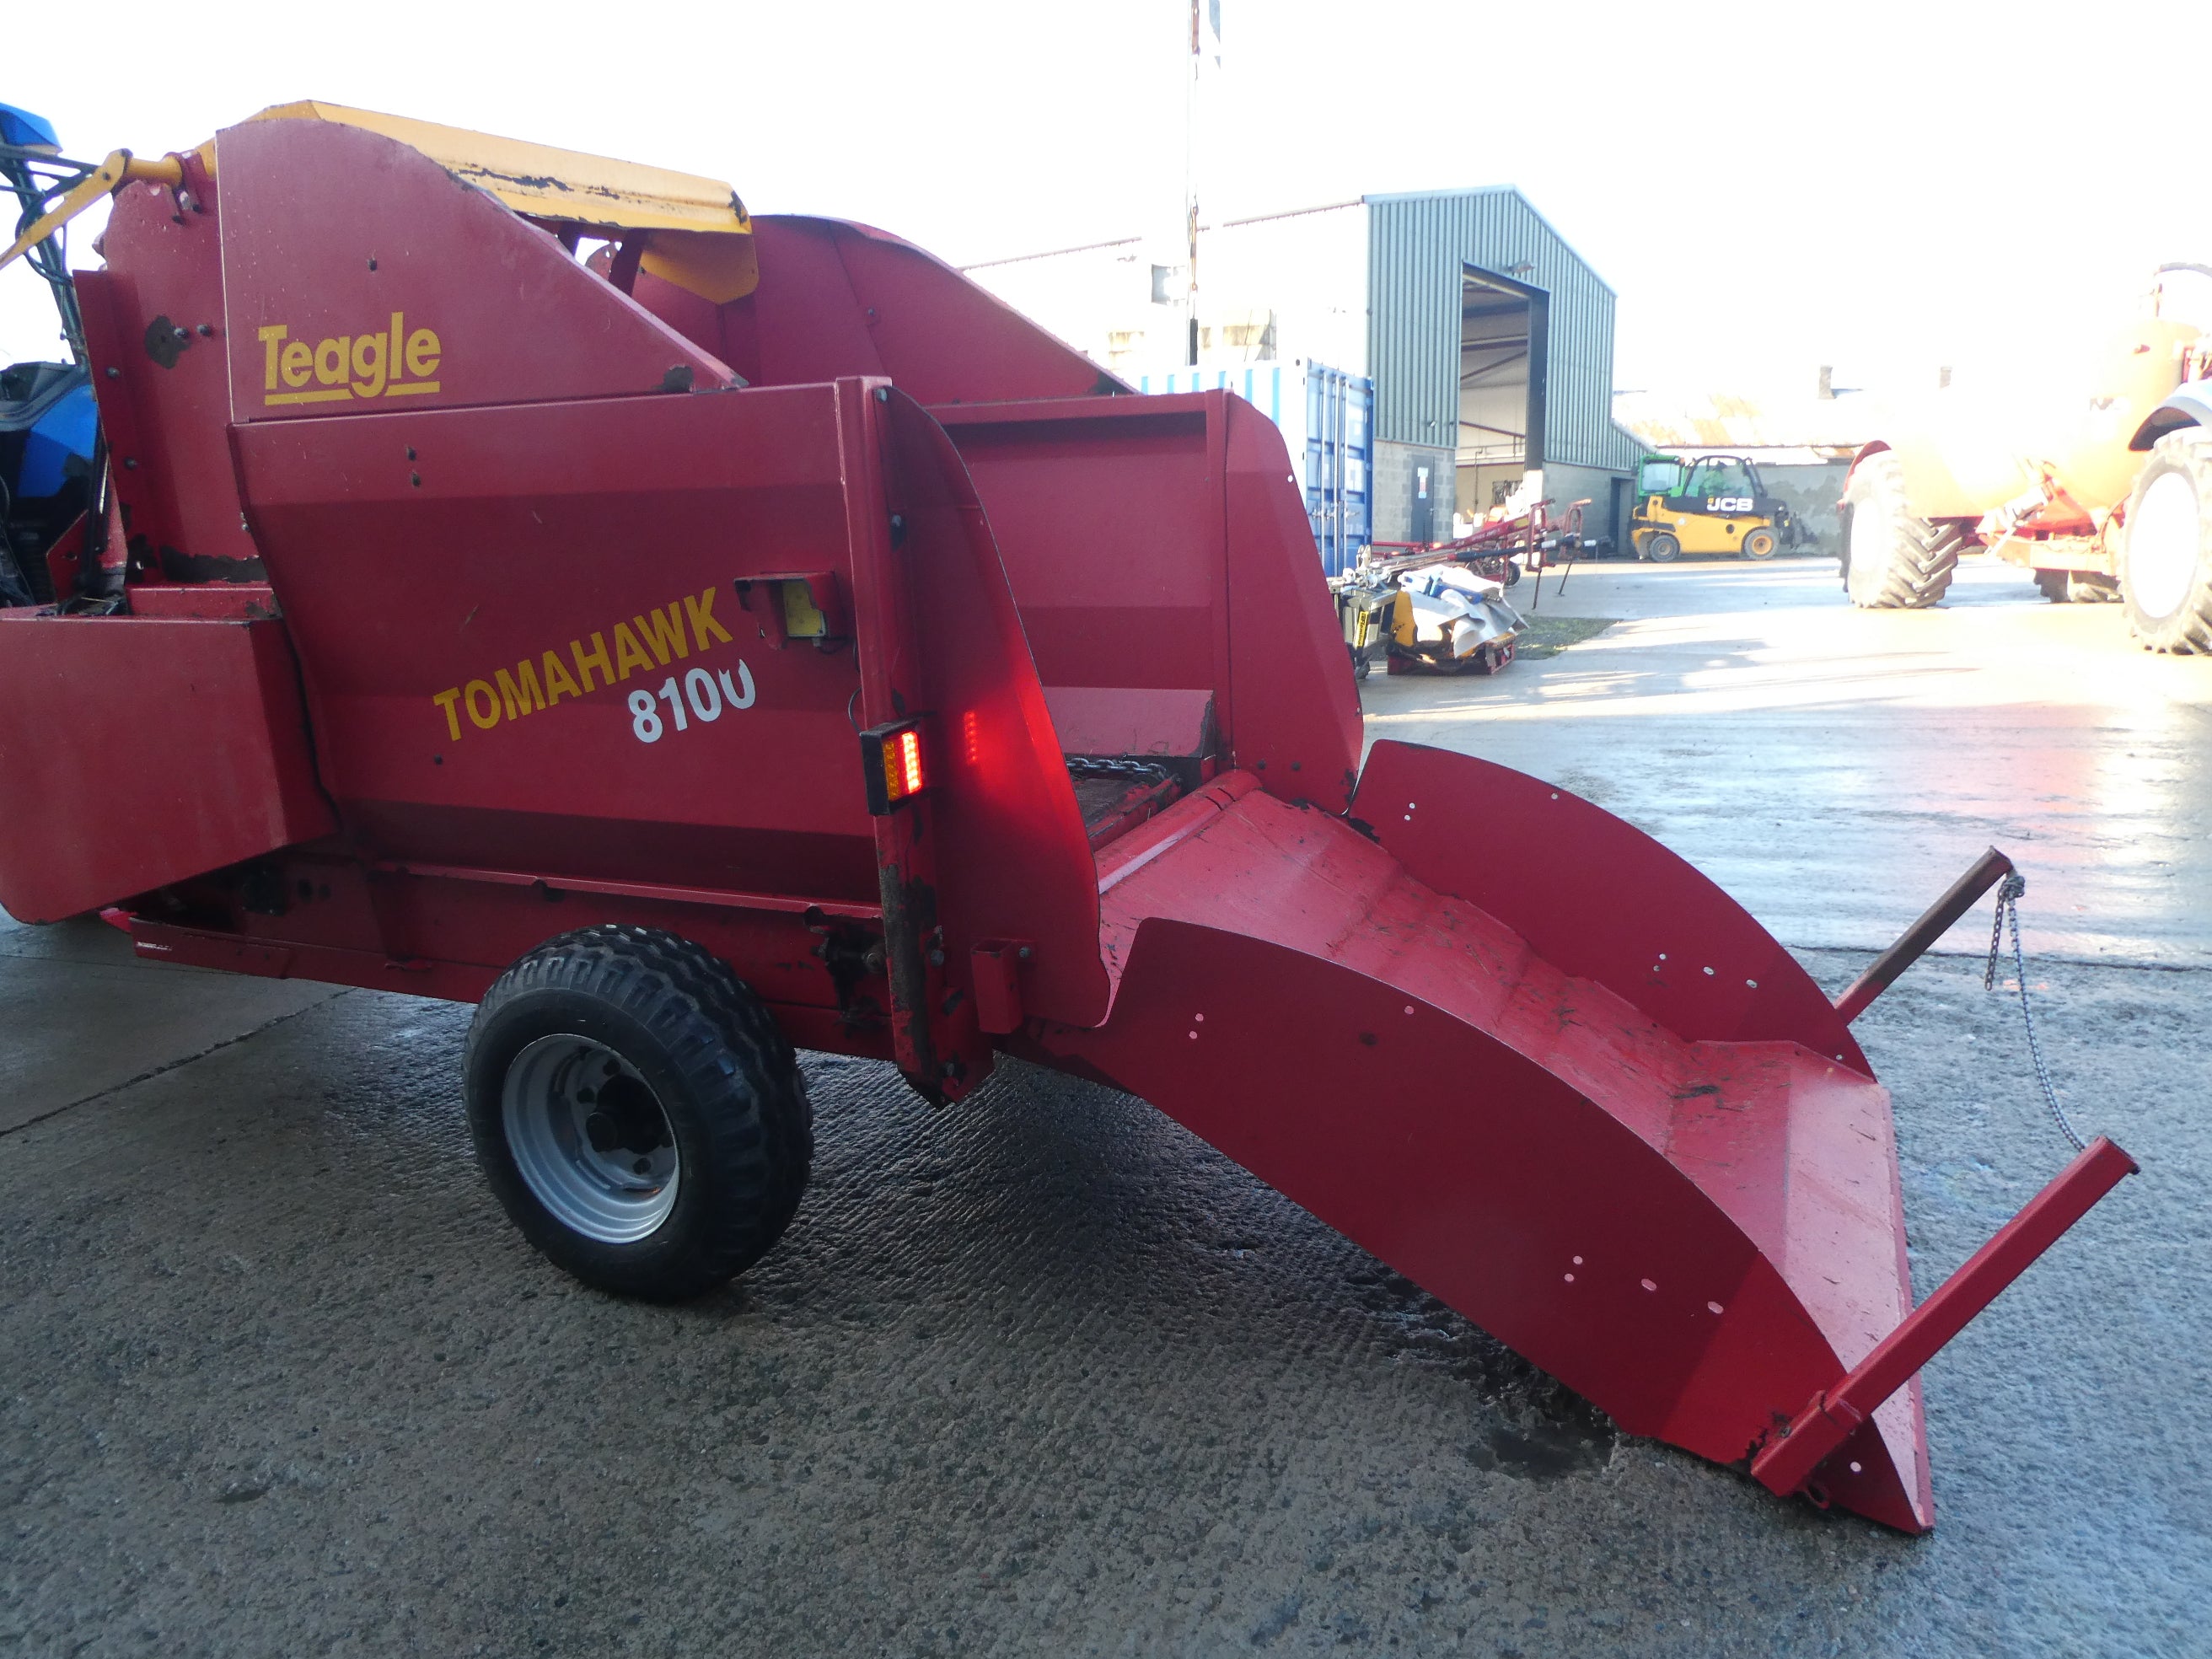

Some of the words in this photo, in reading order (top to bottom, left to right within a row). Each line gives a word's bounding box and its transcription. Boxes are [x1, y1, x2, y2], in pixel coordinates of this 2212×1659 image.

[258, 311, 441, 398] Teagle
[1706, 497, 1753, 512] JCB
[433, 587, 733, 741] TOMAHAWK
[627, 658, 756, 743] 8100
